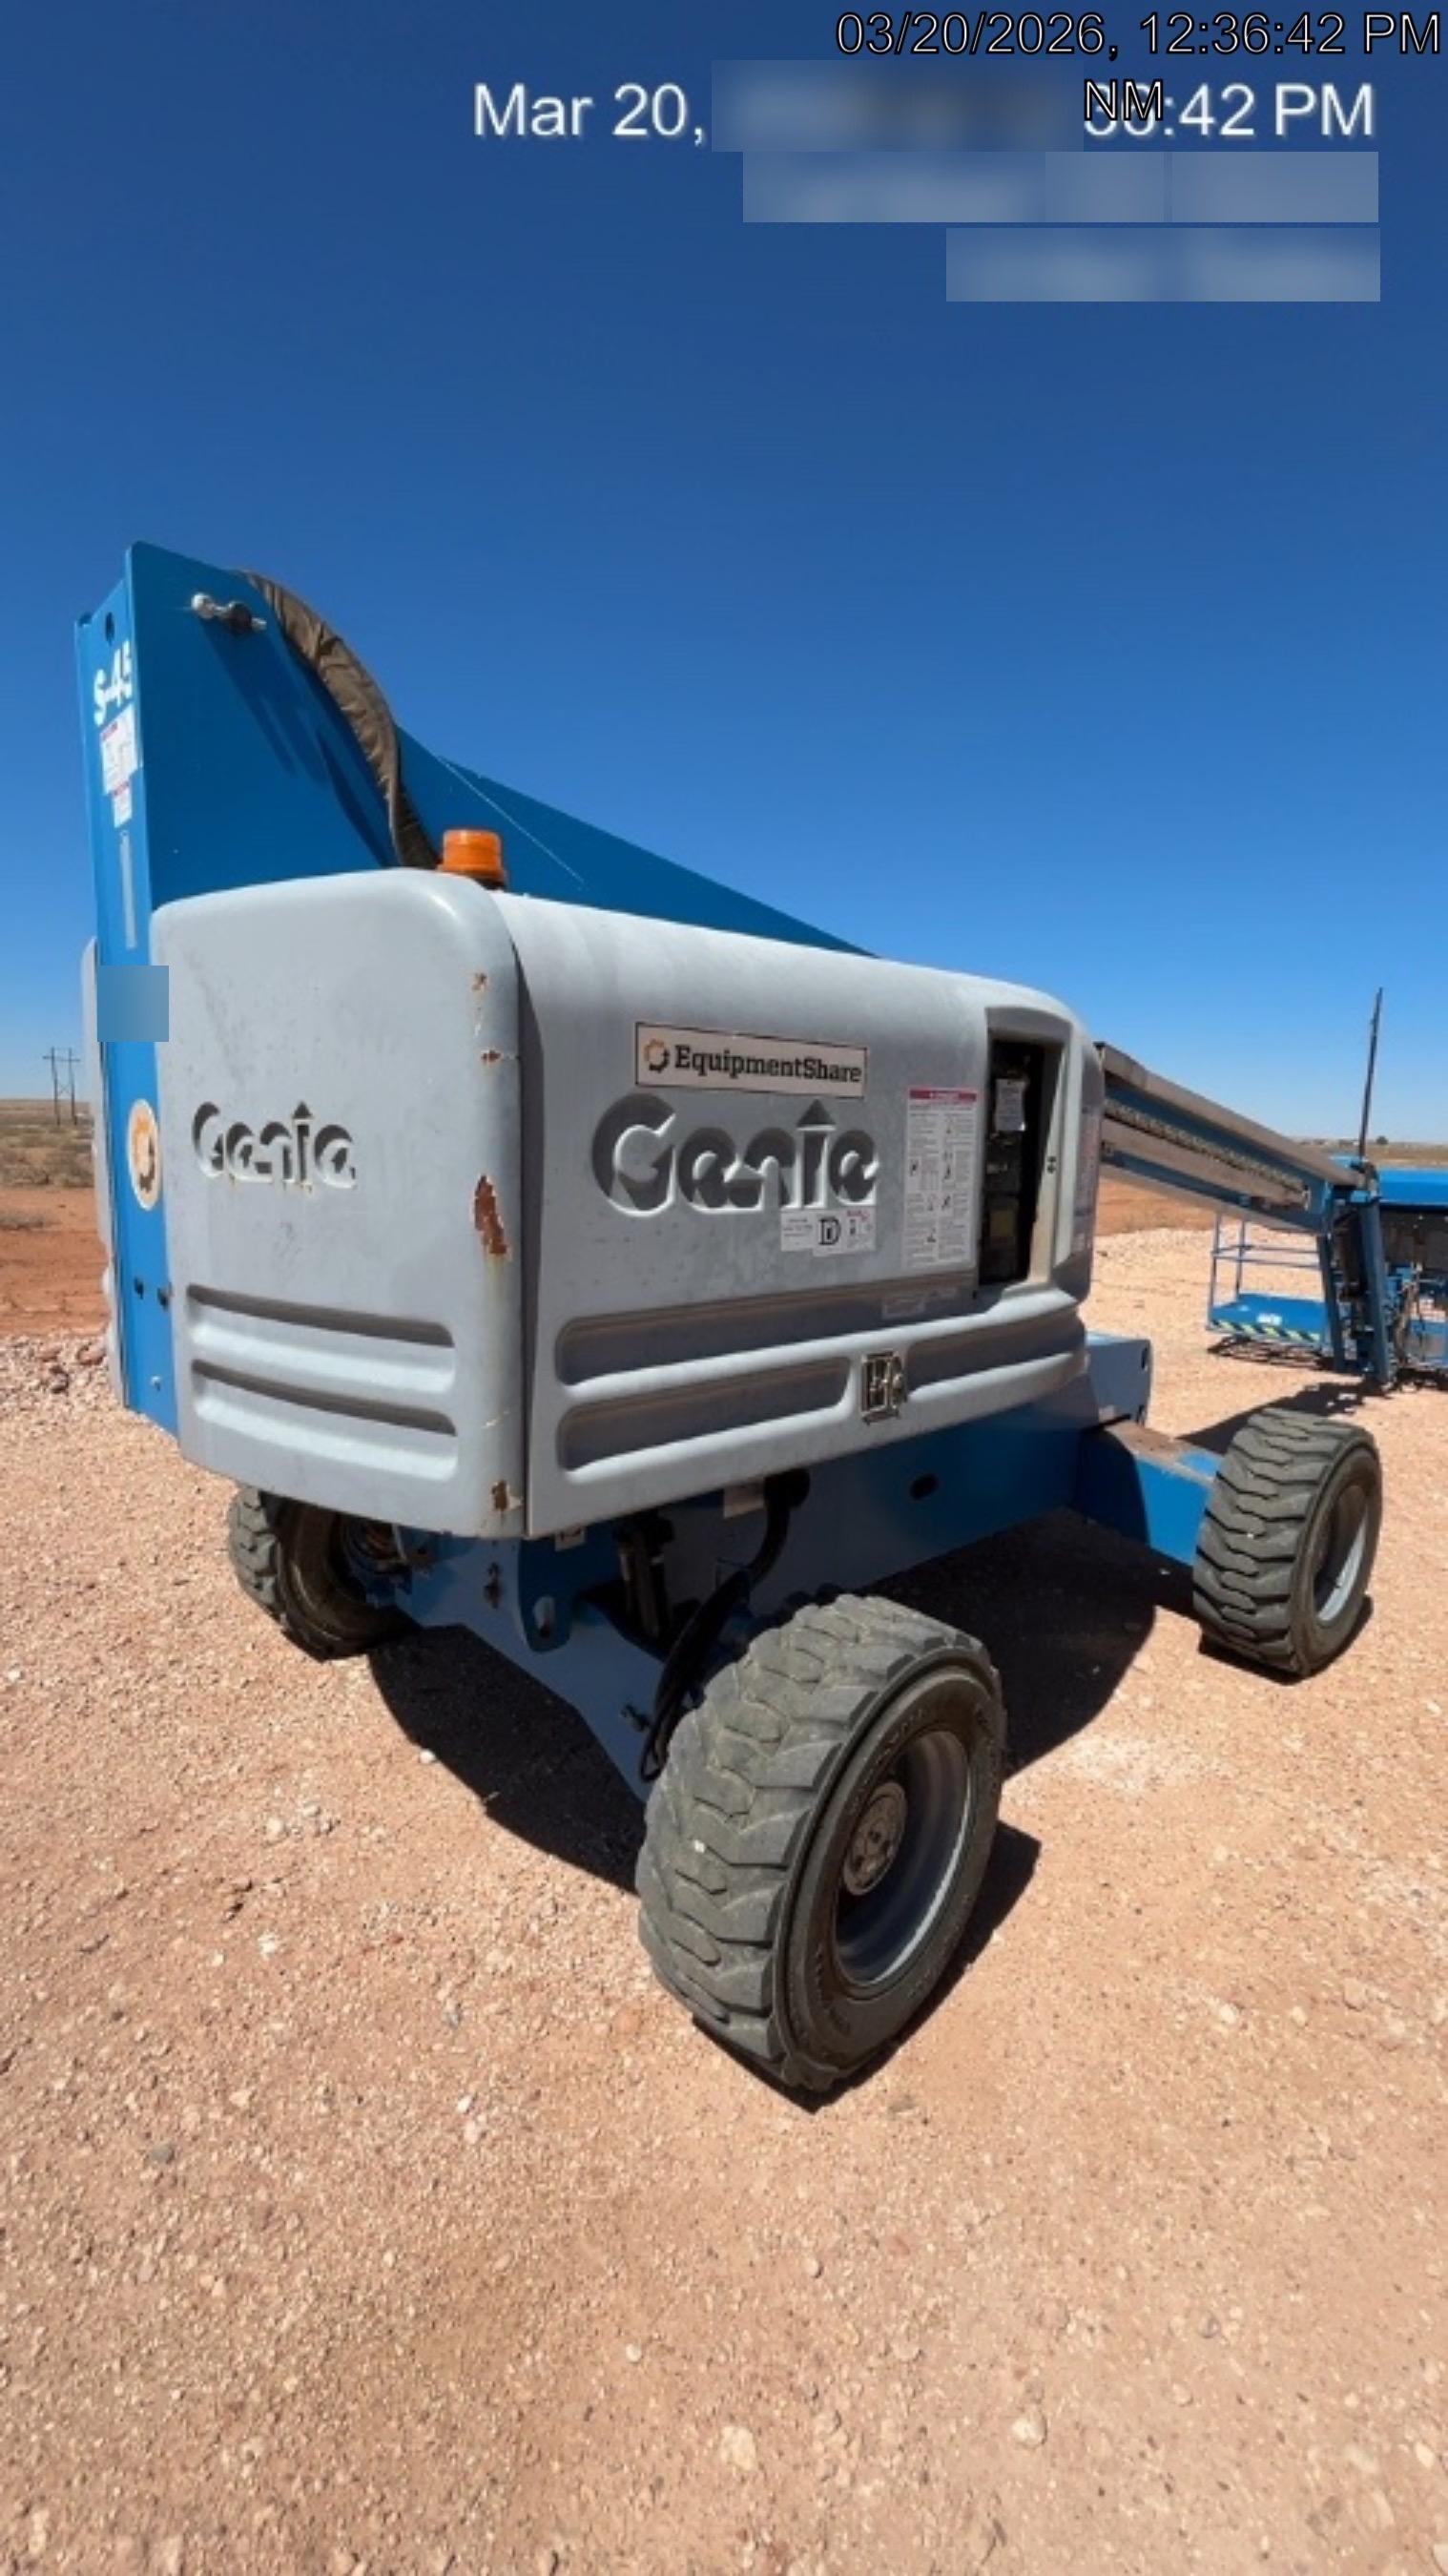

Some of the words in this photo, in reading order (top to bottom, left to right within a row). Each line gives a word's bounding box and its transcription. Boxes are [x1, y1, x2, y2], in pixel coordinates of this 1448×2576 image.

[673, 1044, 863, 1084] EquipmentShare
[193, 1100, 358, 1190] Genie
[591, 1092, 880, 1218] Genie
